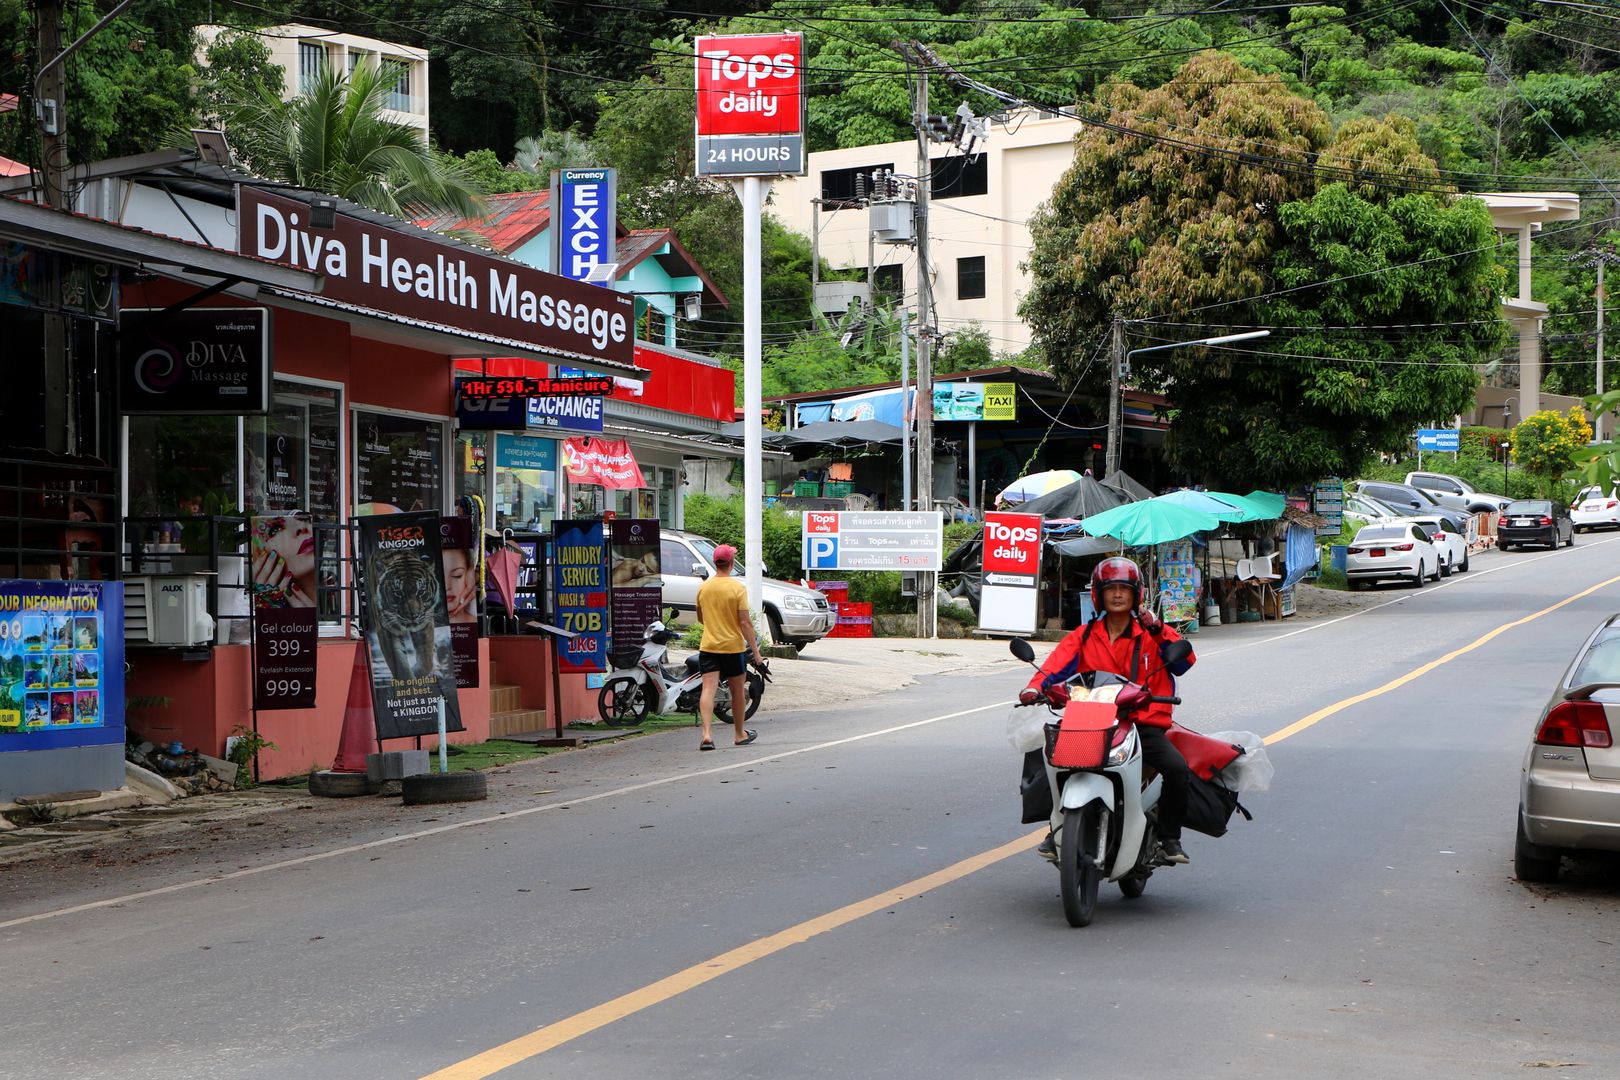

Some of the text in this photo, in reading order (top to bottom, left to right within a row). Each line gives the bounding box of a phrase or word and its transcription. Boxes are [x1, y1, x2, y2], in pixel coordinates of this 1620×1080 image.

[703, 49, 796, 88] Tops
[719, 90, 778, 117] daily
[708, 147, 791, 162] 24 HOURS
[566, 171, 605, 180] Currency
[256, 203, 627, 351] Diva Health Massage
[191, 369, 248, 385] Massage
[464, 380, 492, 395] 1Hr
[538, 378, 610, 393] Manicure
[528, 396, 602, 420] EXCHANGE
[987, 396, 1012, 406] TAXI
[529, 415, 559, 426] Better Rate
[268, 481, 297, 495] Welcome
[811, 514, 835, 525] Tops
[851, 515, 927, 528] ที่จอดรถสำหรับลูกค้า
[376, 525, 424, 541] TIGER
[844, 535, 859, 545] ร้าน
[985, 522, 1038, 546] Tops
[378, 538, 425, 550] KINGDOM
[868, 537, 888, 546] Tops
[910, 535, 934, 546] เท่านั้น
[557, 546, 602, 566] LAUNDRY
[811, 538, 834, 568] P
[848, 555, 894, 565] จอดรถไม่เกิน
[897, 555, 910, 565] 15
[993, 545, 1027, 563] daily
[562, 567, 600, 587] SERVICE
[161, 584, 183, 593] AUX
[22, 595, 98, 611] INFORMATION
[558, 593, 586, 608] WASH &
[260, 623, 313, 635] Gel colour
[562, 612, 602, 632] 70B
[567, 637, 598, 653] 1KG
[260, 665, 314, 675] Eyelash Extension
[390, 675, 437, 688] The original
[396, 688, 411, 698] and
[387, 698, 402, 708] Not
[402, 696, 419, 708] just
